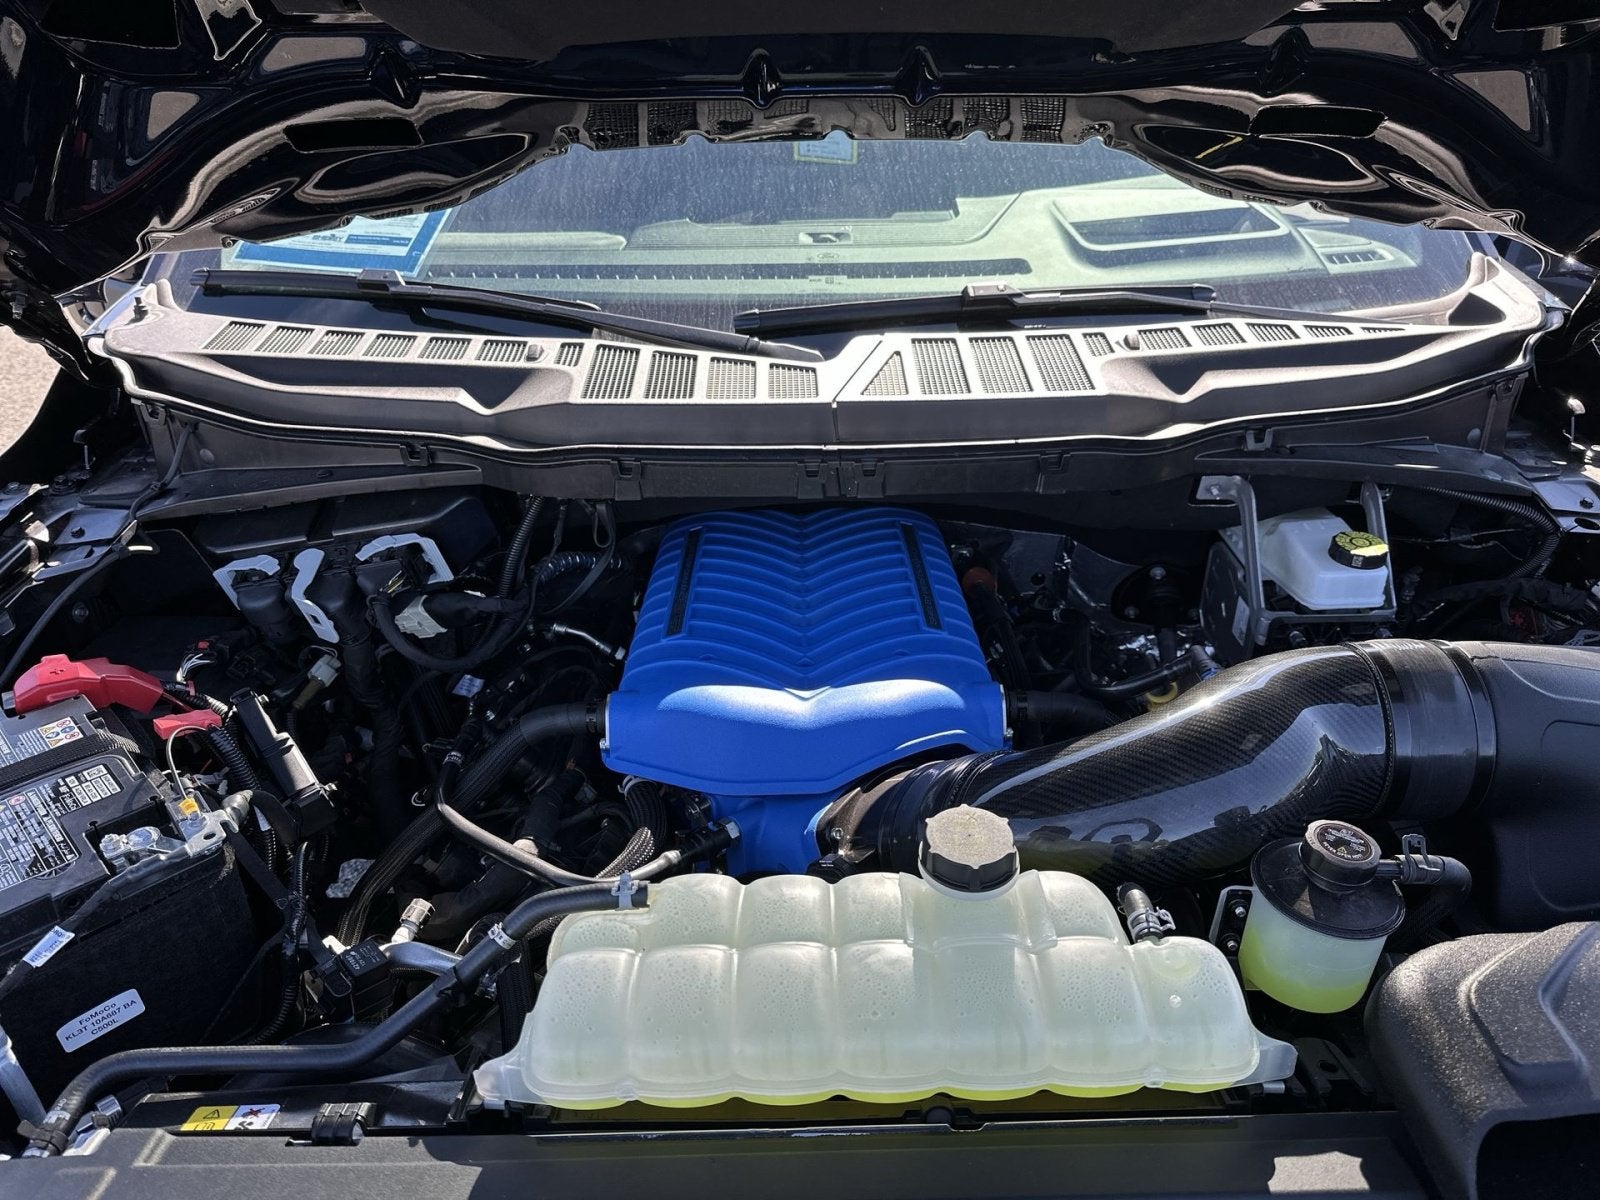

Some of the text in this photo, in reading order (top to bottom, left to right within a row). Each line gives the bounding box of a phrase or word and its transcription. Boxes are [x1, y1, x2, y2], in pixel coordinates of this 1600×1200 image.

[64, 1025, 89, 1041] KL3T
[122, 999, 137, 1010] BA
[78, 1002, 117, 1026] FoMoCo
[90, 1018, 119, 1035] C500L
